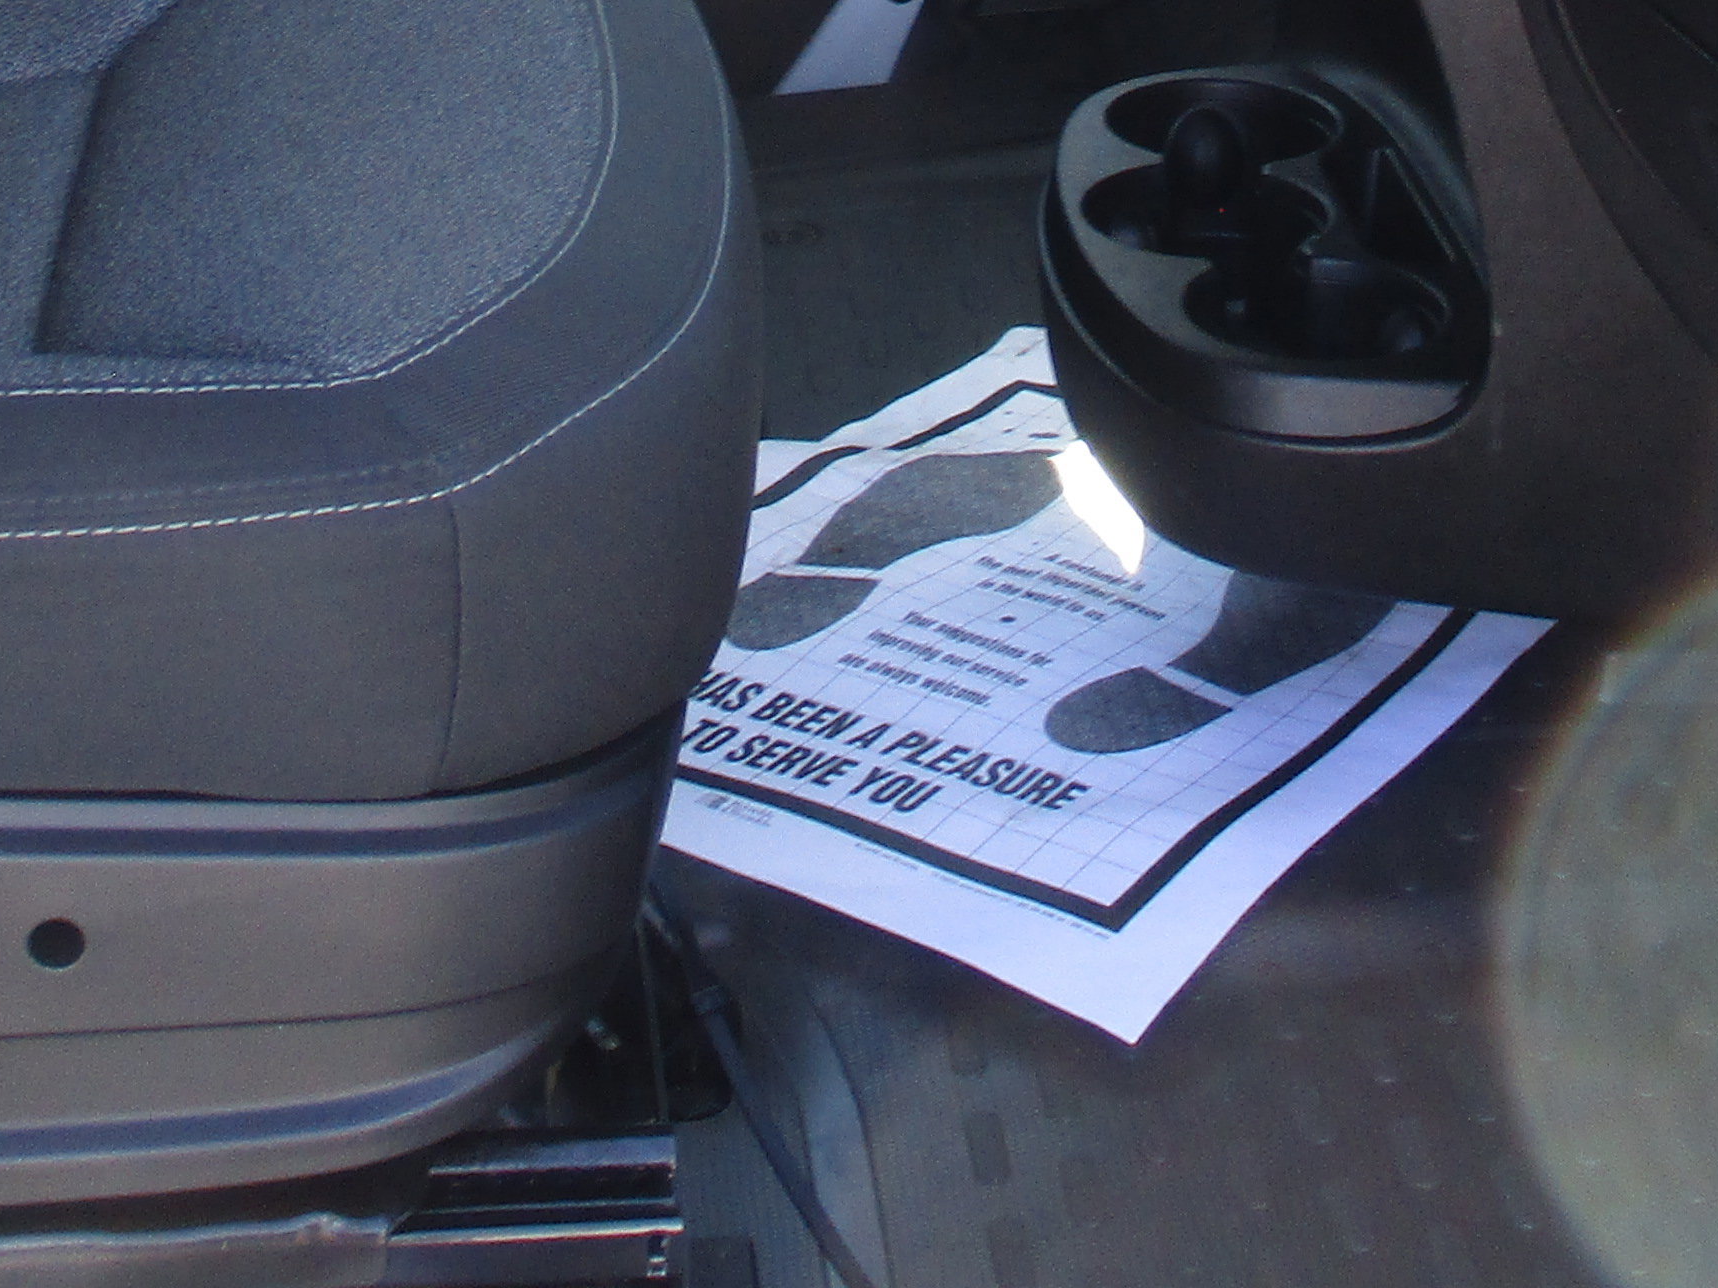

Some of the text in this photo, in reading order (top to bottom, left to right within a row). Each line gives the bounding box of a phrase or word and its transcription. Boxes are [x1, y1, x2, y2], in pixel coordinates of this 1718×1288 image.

[682, 718, 945, 812] TO SERVE YOU
[750, 692, 866, 740] BEEN
[844, 722, 893, 749] A
[880, 729, 1091, 810] PLEASURE
